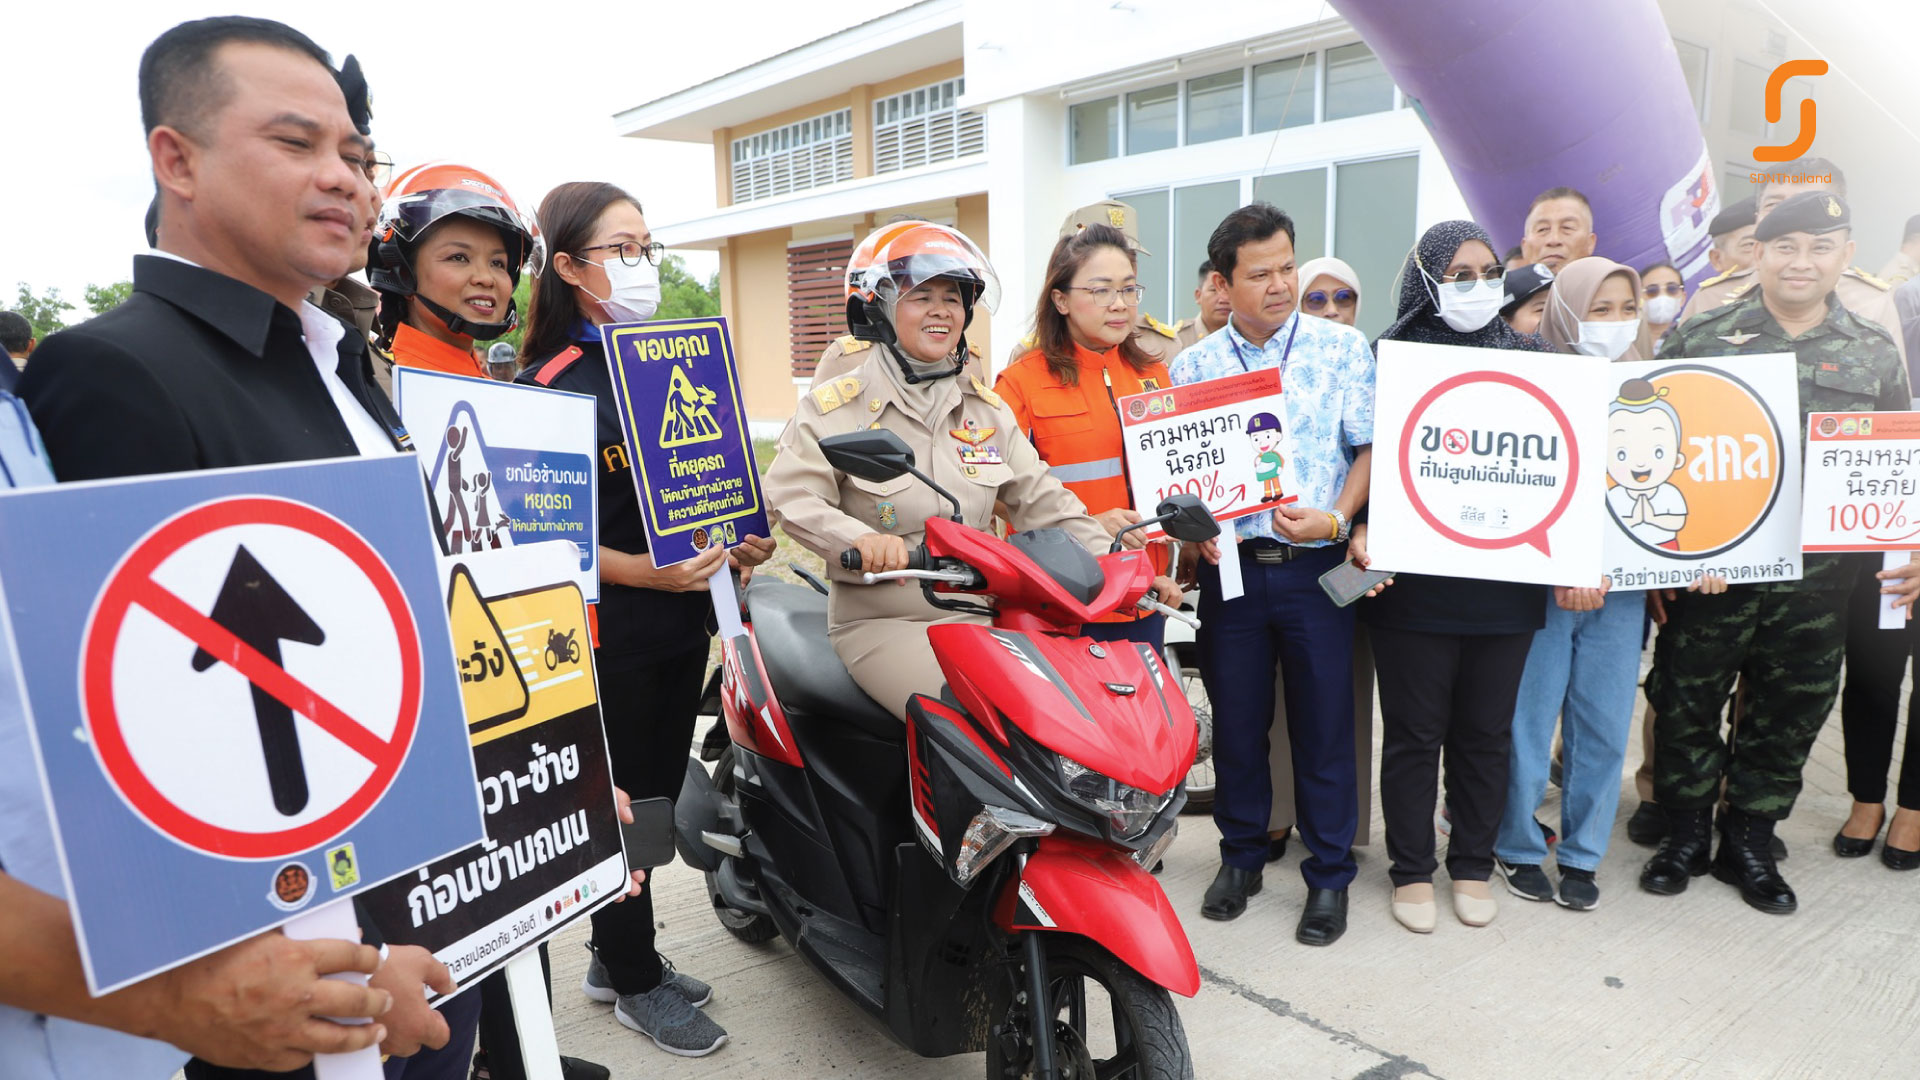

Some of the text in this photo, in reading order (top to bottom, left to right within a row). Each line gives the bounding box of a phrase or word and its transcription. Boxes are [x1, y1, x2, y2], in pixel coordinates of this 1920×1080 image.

[633, 335, 710, 368] ขอบคุณ
[1139, 413, 1241, 451] สวมหมวก
[505, 463, 588, 485] ยกมือข้ามถนน
[668, 450, 725, 480] ที่หยุดรถ
[1165, 440, 1226, 476] นิรภัย
[1420, 456, 1556, 488] ที่ไม่สูบไม่ดื่มไม่เสพ
[1688, 434, 1769, 482] สคล
[660, 477, 742, 504] ให้คนข้ามทางม้าลาย
[1846, 469, 1916, 496] นิรภัย
[524, 493, 572, 516] หยุดรถ
[668, 491, 744, 521] #ความดีที่คุณทำได้
[1827, 500, 1907, 532] 100%
[512, 518, 583, 532] ให้คนข้ามทางม้าลาย
[457, 640, 504, 685] ะวัง
[477, 742, 580, 815] วา-ซ้าย
[407, 809, 590, 928] ก่อนข้ามถนน
